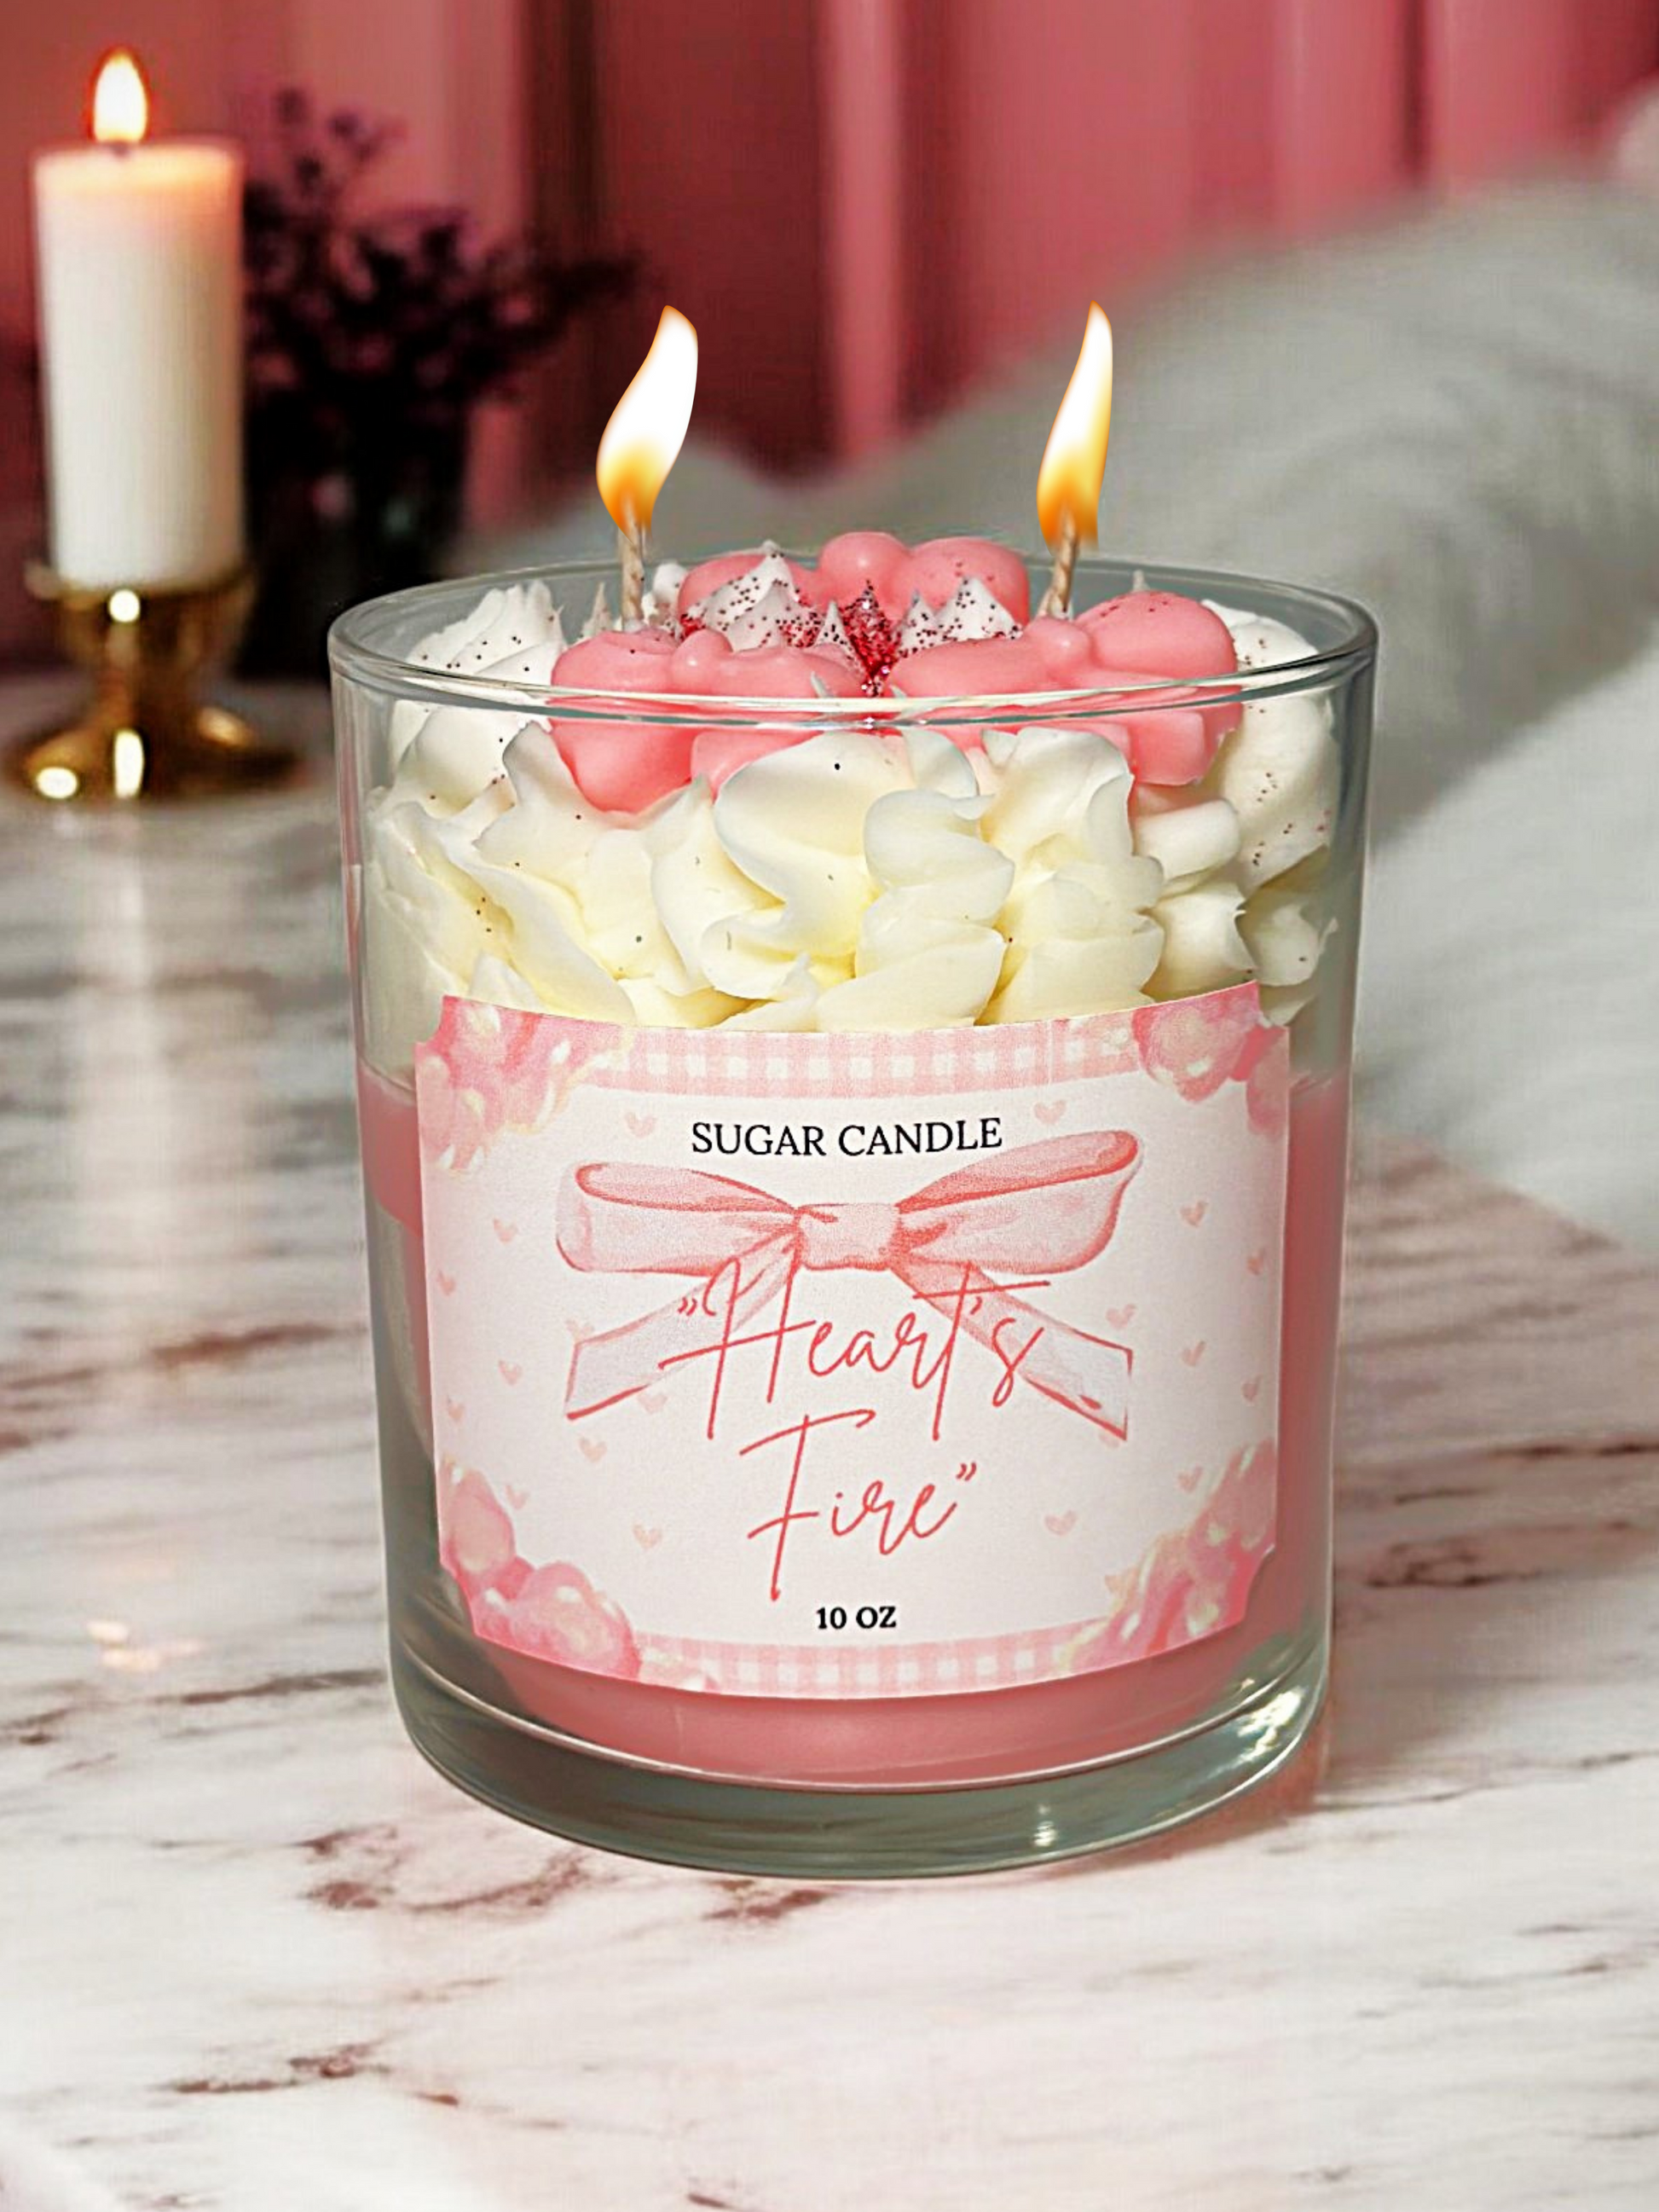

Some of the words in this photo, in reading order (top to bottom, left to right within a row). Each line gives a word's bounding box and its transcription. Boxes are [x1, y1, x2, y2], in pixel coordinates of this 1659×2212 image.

[692, 1121, 826, 1156] SUGAR
[838, 1117, 1003, 1156] CANDLE
[817, 1607, 847, 1630] 10
[855, 1606, 898, 1630] OZ
